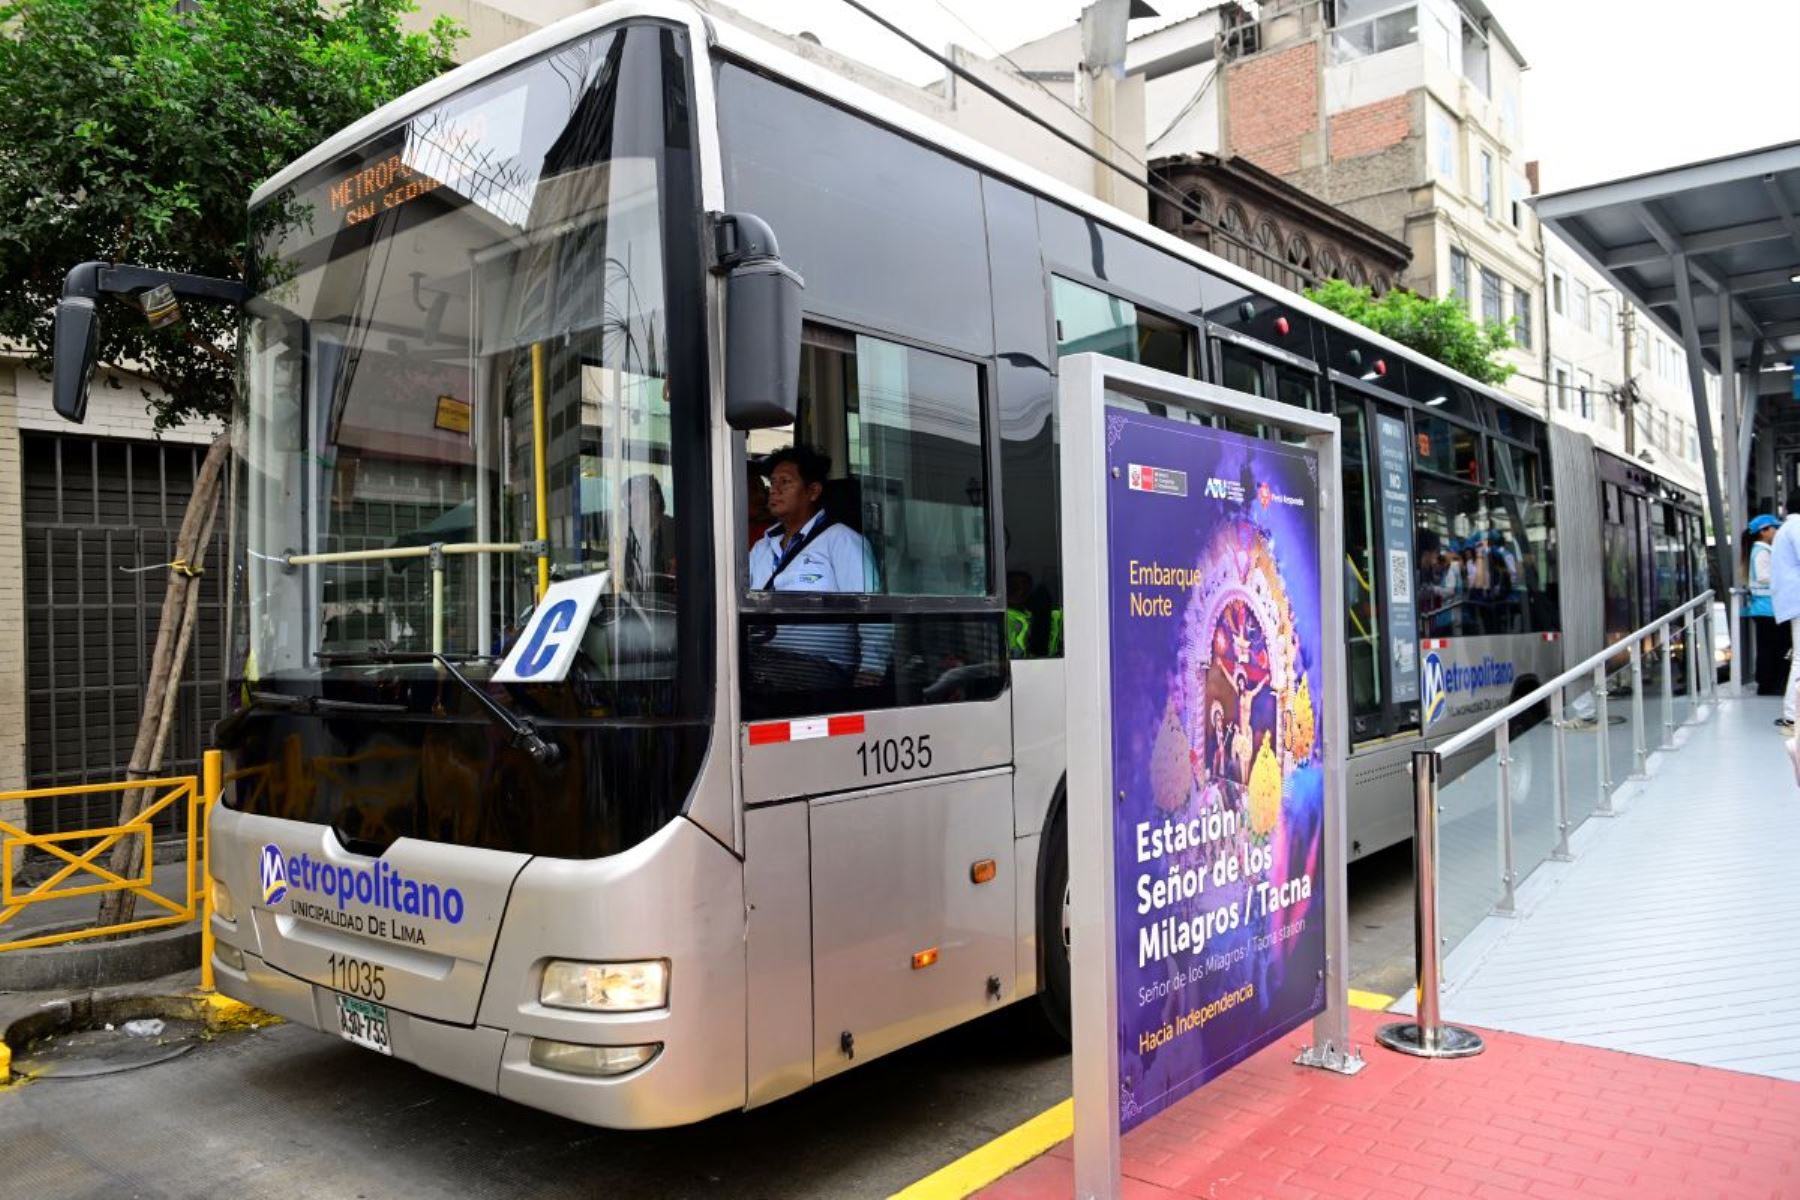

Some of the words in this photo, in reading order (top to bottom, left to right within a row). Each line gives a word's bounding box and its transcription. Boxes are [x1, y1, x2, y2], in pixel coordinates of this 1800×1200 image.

[1130, 560, 1201, 592] Embarque
[1130, 592, 1172, 617] Norte
[515, 599, 577, 678] C
[857, 734, 932, 776] 11035
[1136, 804, 1235, 863] Estación
[260, 842, 464, 924] Metropolitano
[1137, 864, 1207, 915] Señor
[1213, 850, 1239, 887] de
[1244, 842, 1272, 876] los
[1139, 902, 1239, 968] Milagros
[1244, 886, 1253, 926] /
[1257, 873, 1311, 916] Tacna
[328, 953, 386, 1001] 11035
[1139, 979, 1171, 1007] Señor
[1173, 972, 1186, 991] de
[1188, 964, 1203, 983] los
[1205, 949, 1244, 976] Milagros
[1253, 933, 1277, 953] Tacna
[1139, 1022, 1173, 1056] Hacia
[1176, 982, 1254, 1036] Independencia
